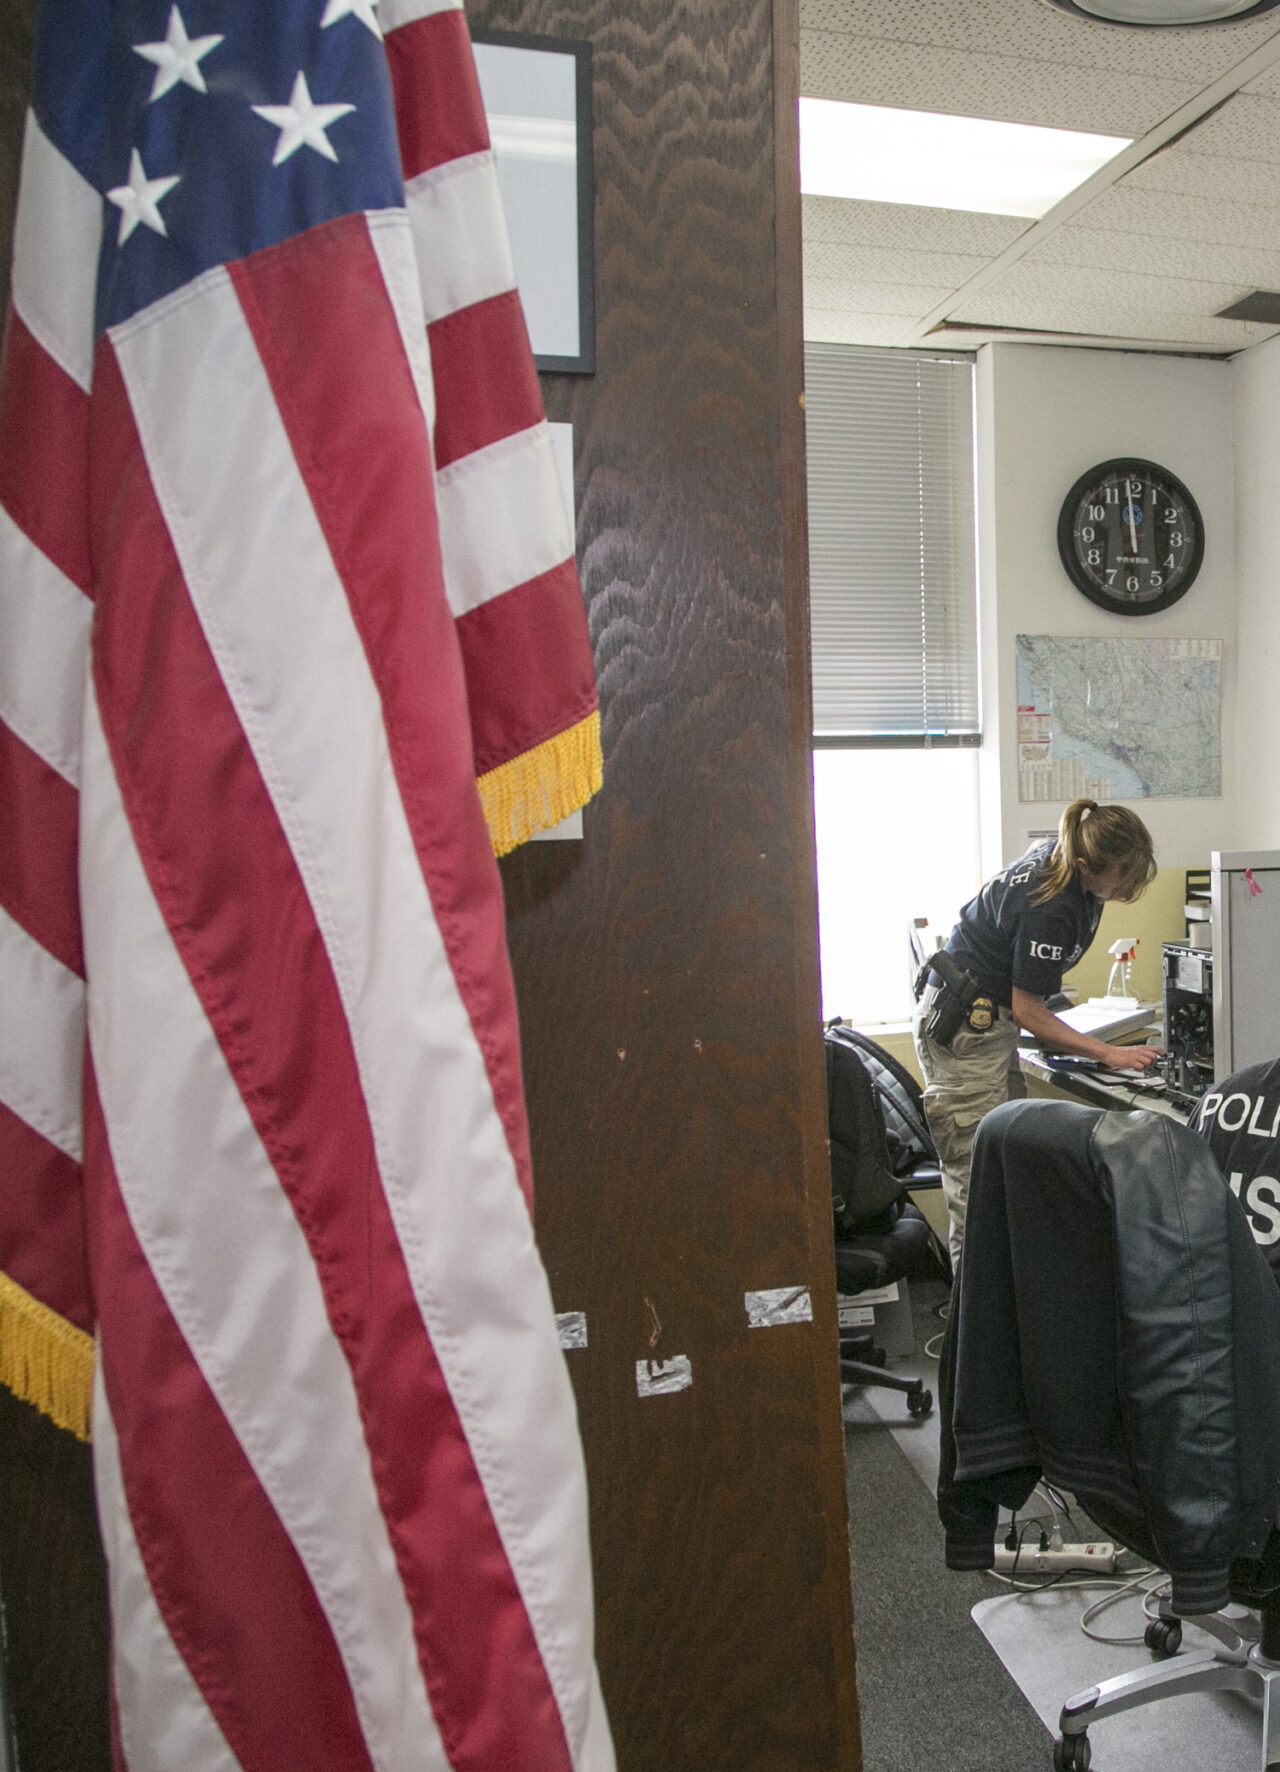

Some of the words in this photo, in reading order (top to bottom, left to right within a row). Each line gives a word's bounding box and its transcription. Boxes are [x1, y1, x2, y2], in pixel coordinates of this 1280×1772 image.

[1105, 487, 1119, 504] 11
[1151, 488, 1158, 505] 1
[1088, 504, 1106, 521] 10
[1164, 508, 1178, 524] 2
[1082, 526, 1096, 543] 9
[1170, 531, 1183, 548] 3
[1087, 548, 1101, 565] 8
[1162, 552, 1175, 569] 4
[1105, 568, 1118, 585] 7
[1126, 575, 1140, 592] 6
[1150, 570, 1163, 587] 5
[1029, 940, 1063, 961] ICE
